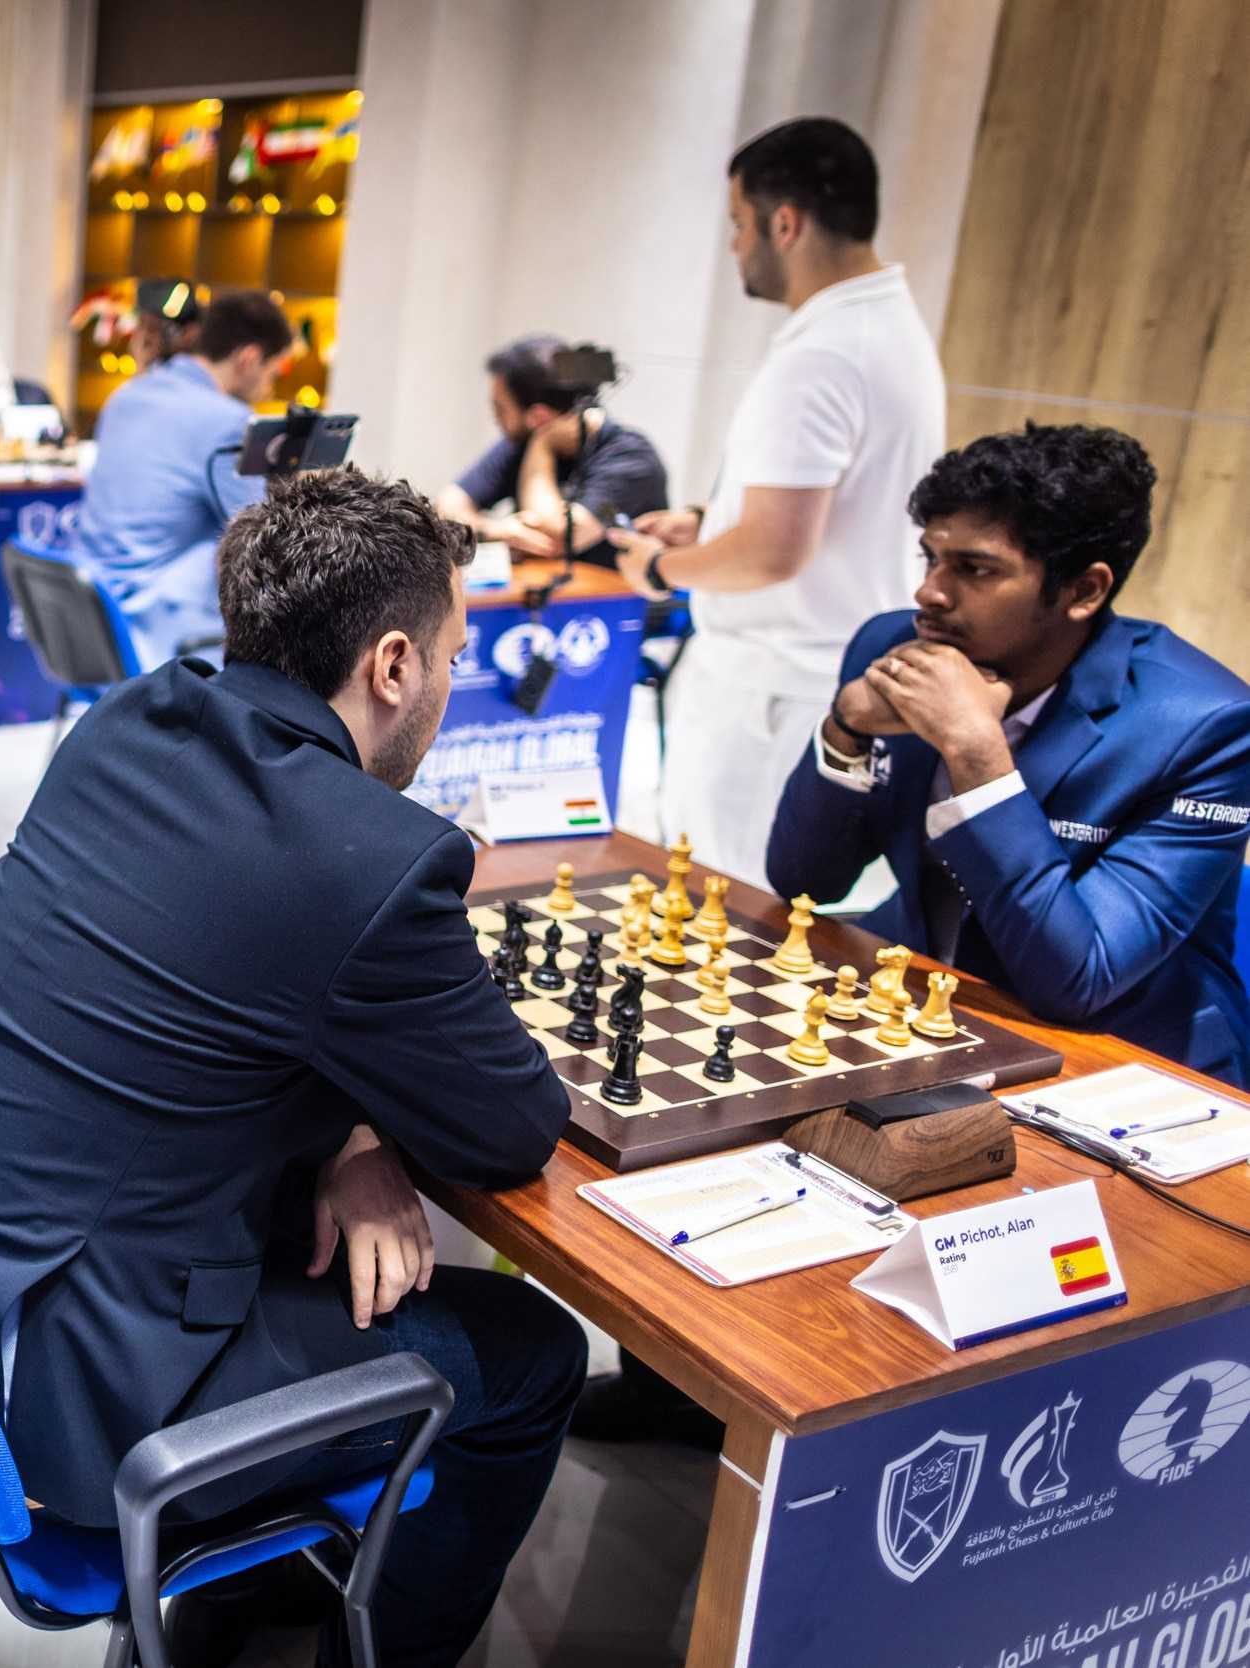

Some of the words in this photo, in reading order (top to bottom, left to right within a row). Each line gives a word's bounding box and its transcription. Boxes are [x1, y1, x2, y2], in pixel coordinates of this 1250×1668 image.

[1049, 818, 1116, 843] WESTBRID
[934, 1235, 957, 1252] GM
[959, 1225, 1005, 1246] Pichot,
[1007, 1218, 1036, 1235] Alan
[939, 1252, 967, 1265] Rating
[1159, 1459, 1196, 1486] FIDE
[1056, 1494, 1093, 1519] الفجيرة
[1093, 1486, 1118, 1509] نادي
[962, 1544, 1006, 1567] Fujairah
[1008, 1533, 1038, 1551] Chess
[1040, 1528, 1050, 1540] &
[1051, 1514, 1089, 1536] Culture
[1091, 1505, 1115, 1521] Club
[965, 1525, 1006, 1548] والثقافة
[1007, 1507, 1055, 1540] للشطرنج
[1051, 1591, 1157, 1657] العالمية
[1149, 1593, 1250, 1668] GLOB
[997, 1633, 1046, 1668] الأول
